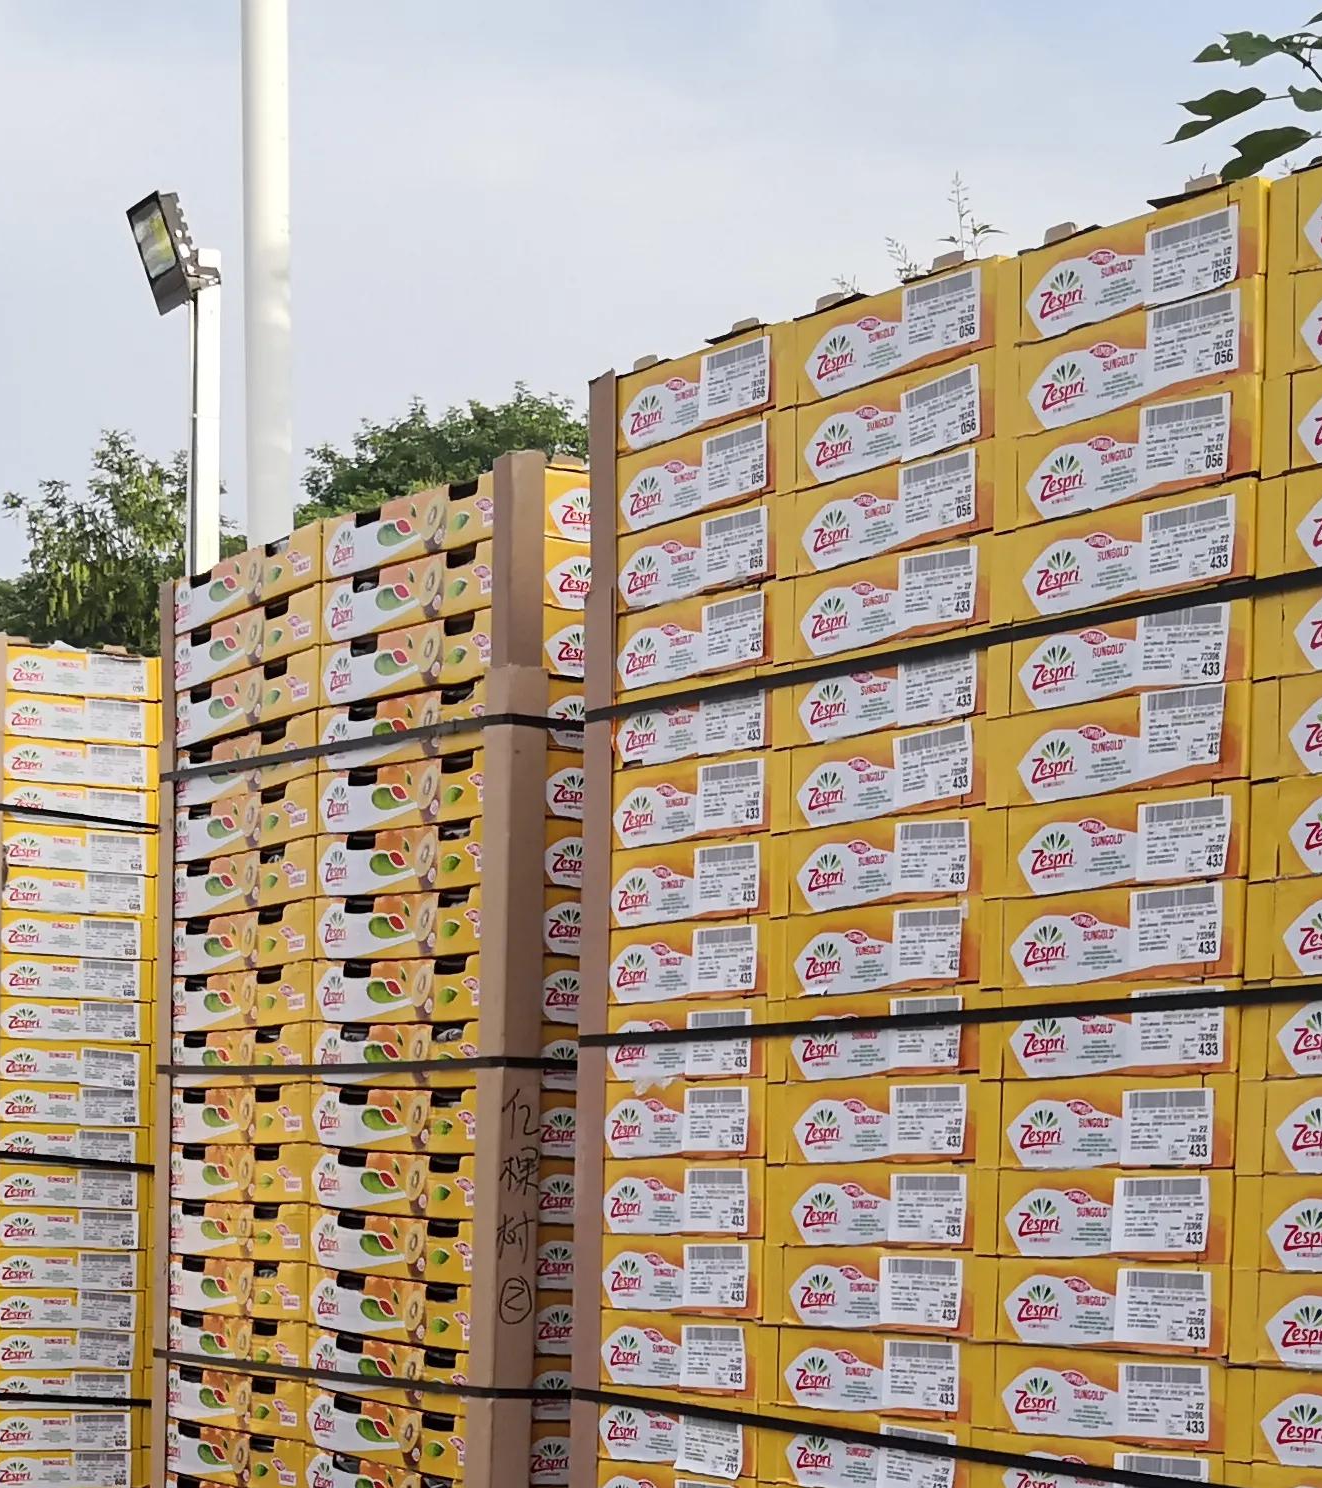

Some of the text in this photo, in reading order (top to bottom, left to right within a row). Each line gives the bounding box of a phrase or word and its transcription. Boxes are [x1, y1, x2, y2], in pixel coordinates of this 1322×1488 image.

[1101, 261, 1132, 277] SUNGOLD
[1041, 289, 1083, 318] Zespri
[1214, 350, 1233, 365] 056
[631, 412, 661, 435] Zespri
[815, 441, 851, 468] Zespri
[1206, 454, 1223, 469] 056
[1098, 545, 1129, 562] SUNGOLD
[1209, 553, 1228, 570] 433
[1037, 569, 1079, 596] Zespri
[809, 700, 847, 727] Zespri
[1031, 849, 1074, 875] Zespri
[1206, 853, 1224, 869] 433
[1078, 1116, 1109, 1127] SUNGOLD
[1018, 1124, 1062, 1151] Zespri
[1189, 1144, 1207, 1157] 433
[1186, 1232, 1203, 1245] 433
[1184, 1419, 1205, 1435] 433
